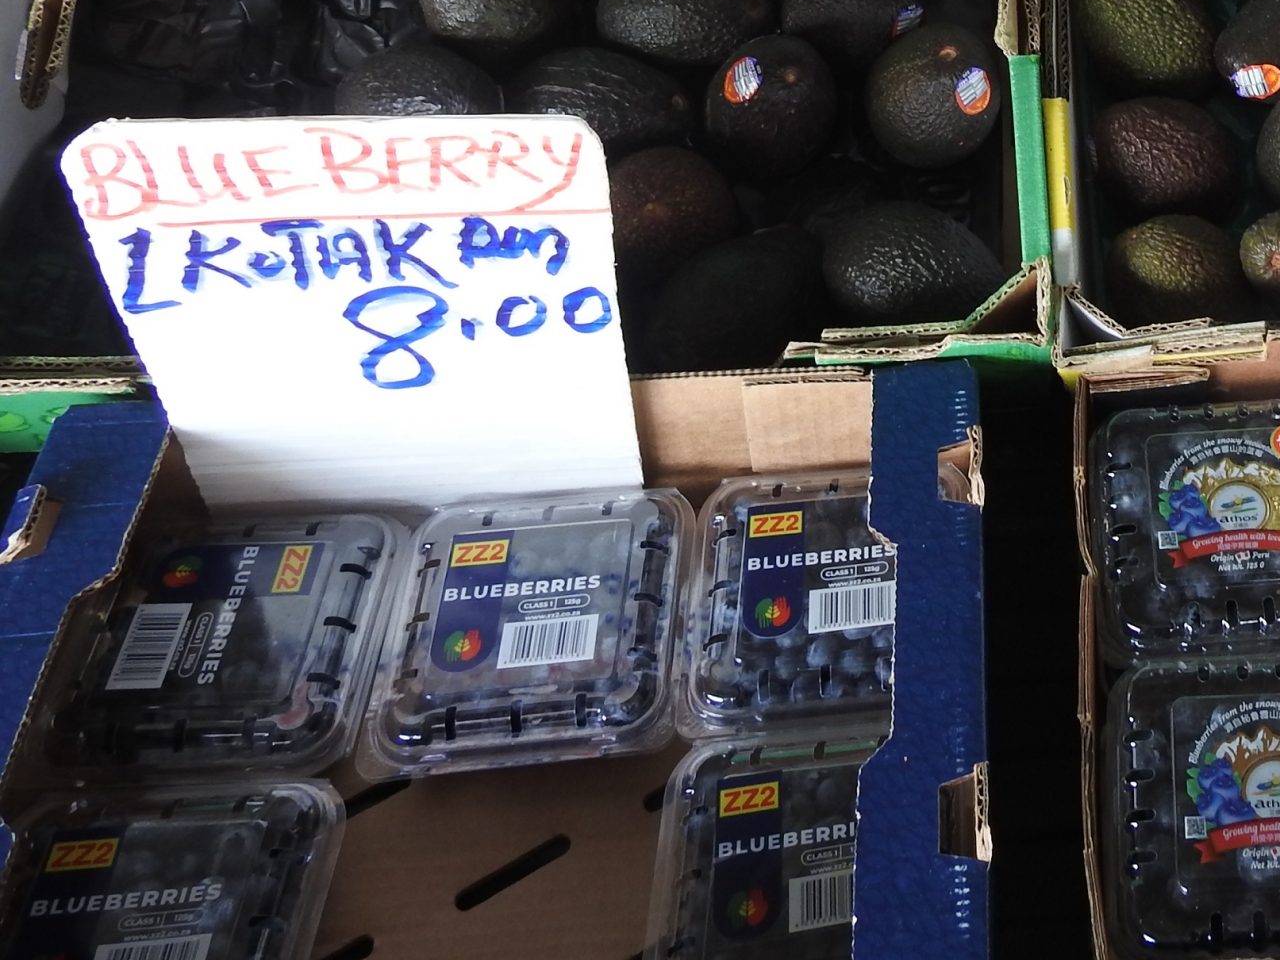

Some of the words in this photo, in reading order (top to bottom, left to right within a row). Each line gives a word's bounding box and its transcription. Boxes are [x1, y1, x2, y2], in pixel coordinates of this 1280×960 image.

[752, 514, 800, 535] ZZ2
[1225, 532, 1248, 541] health
[453, 542, 506, 564] ZZ2
[747, 544, 896, 571] BLUEBERRIES
[1210, 552, 1235, 563] Origin
[274, 545, 310, 591] ZZ2
[824, 569, 850, 578] CLASS
[443, 574, 601, 602] BLUEBERRIES
[197, 545, 260, 685] BLUEBERRIES
[523, 601, 549, 610] CLASS
[1217, 708, 1238, 725] from
[1239, 702, 1253, 712] the
[723, 785, 776, 814] ZZ2
[1222, 825, 1258, 840] Growing
[50, 841, 115, 869] ZZ2
[806, 851, 834, 862] CLASS
[1242, 846, 1270, 859] Origin
[1250, 861, 1265, 870] Net
[29, 882, 223, 918] BLUEBERRIES
[122, 916, 157, 926] CLASS
